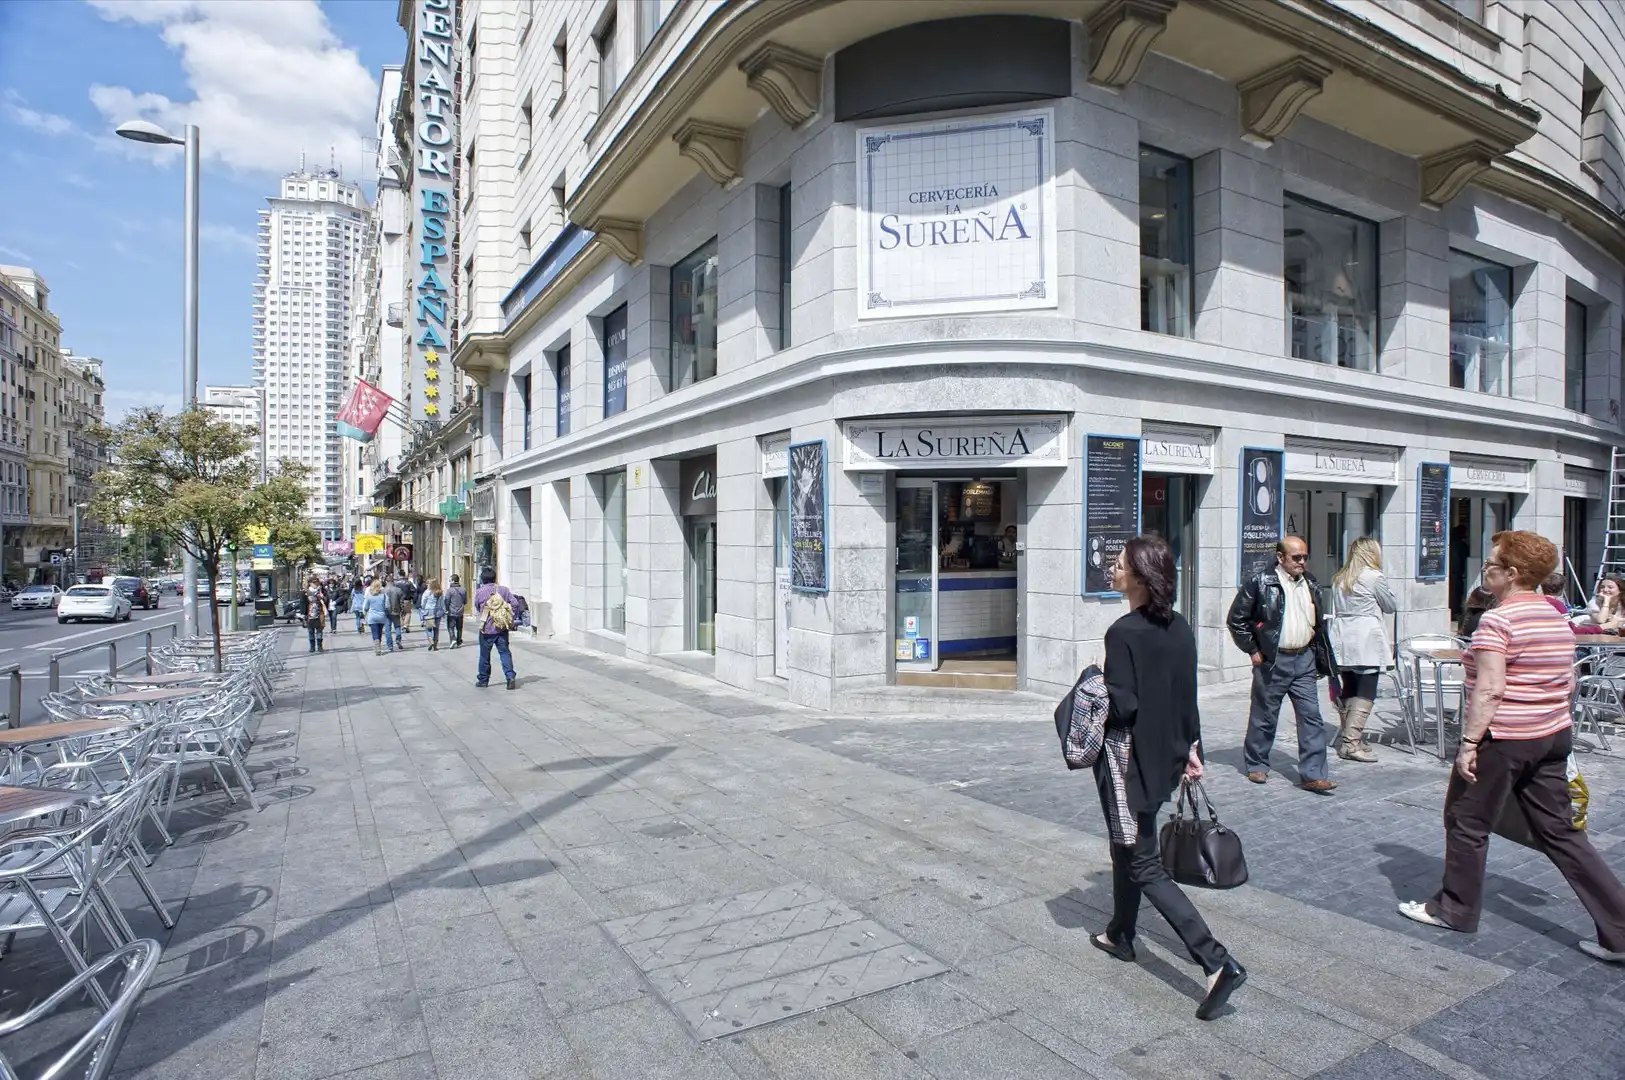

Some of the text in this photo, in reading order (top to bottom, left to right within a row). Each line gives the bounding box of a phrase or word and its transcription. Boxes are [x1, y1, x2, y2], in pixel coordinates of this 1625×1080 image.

[909, 183, 999, 204] CERVECERÍA
[945, 204, 962, 216] LA
[879, 203, 1032, 250] SUREÑA
[416, 189, 449, 347] ESPAÑA
[875, 427, 1032, 458] LA SUREÑA
[692, 470, 718, 500] Cla
